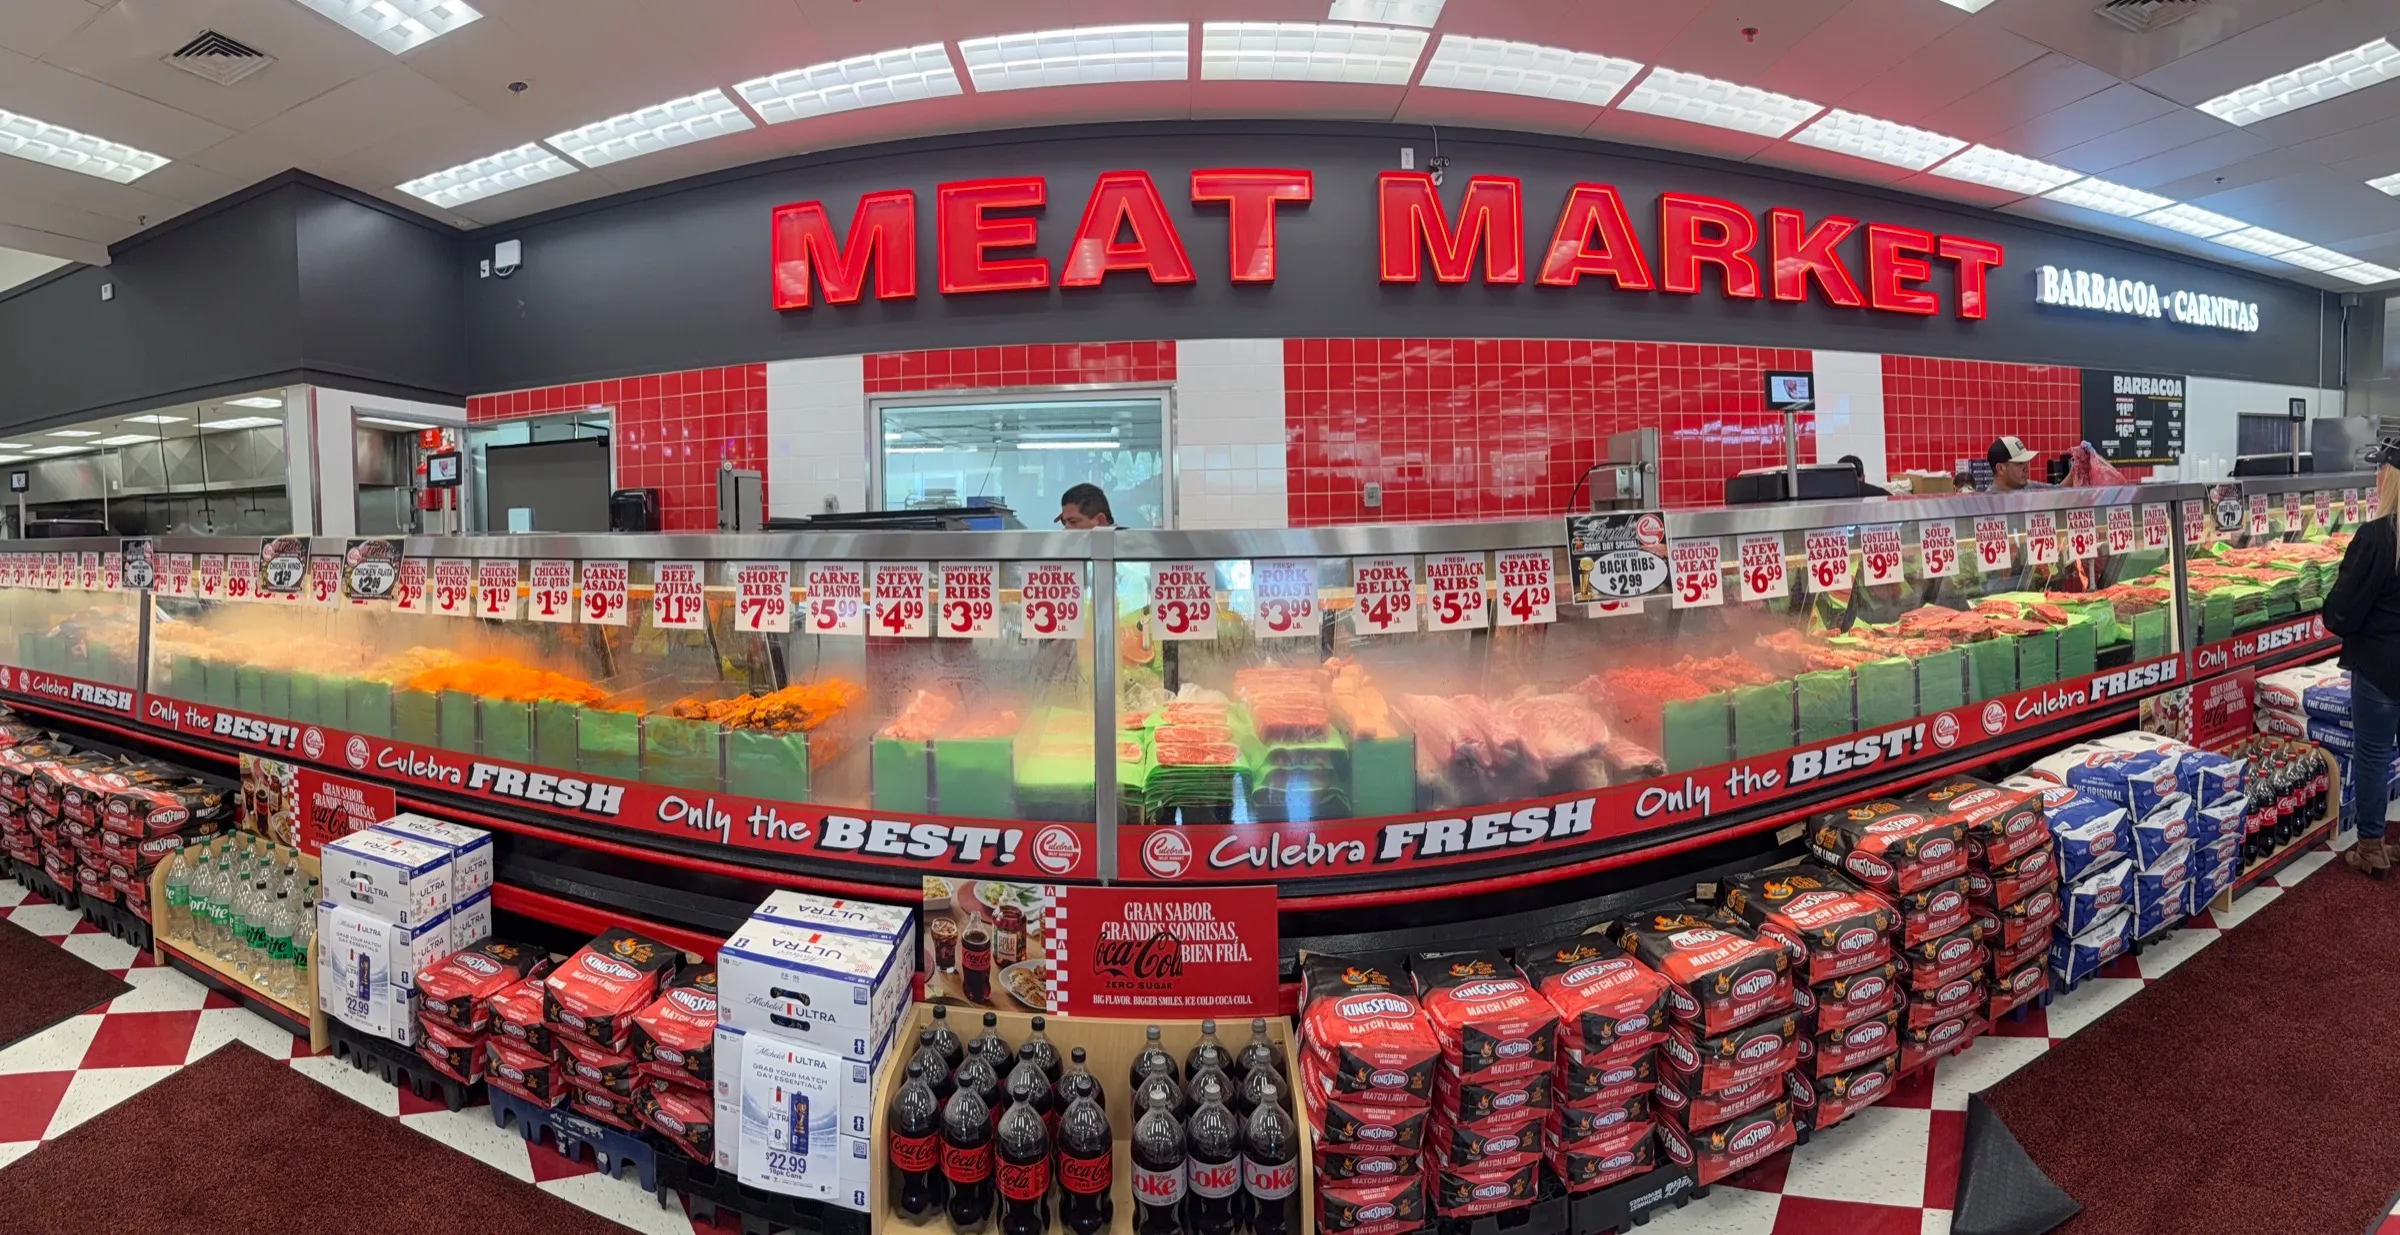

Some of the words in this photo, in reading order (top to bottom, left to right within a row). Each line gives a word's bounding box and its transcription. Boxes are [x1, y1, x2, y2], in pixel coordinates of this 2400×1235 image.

[771, 169, 1313, 312] MEAT
[1377, 171, 2003, 321] MARKET
[2035, 265, 2162, 318] BARBACOA
[2168, 290, 2258, 332] CARNITAS
[2114, 376, 2182, 396] BARBACOA
[2067, 511, 2094, 521] CARNE
[2108, 513, 2131, 522] CARNE
[2031, 518, 2051, 528] BEEF
[2068, 520, 2094, 530] ASADA
[2109, 520, 2132, 529] CECINA
[1862, 531, 1900, 544] COSTILLA
[1925, 528, 1951, 539] SOUP
[2027, 527, 2056, 537] MILANESA
[1584, 542, 1601, 551] GAME
[1603, 542, 1613, 550] DAY
[1615, 540, 1638, 549] SPECIAL
[1806, 536, 1847, 549] CARNE
[1863, 543, 1900, 555] CARGADA
[1922, 538, 1955, 549] BONES
[1671, 547, 1719, 561] GROUND
[1742, 543, 1779, 556] STEW
[1808, 548, 1848, 561] ASADA
[230, 561, 250, 569] FRYER
[312, 562, 339, 570] CHICKEN
[1500, 559, 1550, 573] SPARE
[1600, 560, 1628, 574] BACK
[1631, 557, 1655, 571] RIBS
[1675, 560, 1716, 573] MEAT
[1743, 554, 1780, 567] MEAT
[201, 567, 222, 575] BREAST
[312, 571, 337, 580] FAJITA
[435, 566, 470, 576] CHICKEN
[480, 567, 517, 577] CHICKEN
[583, 568, 626, 580] CARNE
[662, 571, 695, 581] BEEF
[1262, 570, 1309, 583] PORK
[1359, 567, 1408, 581] PORK
[1427, 563, 1484, 577] BABYBACK
[437, 576, 468, 586] WINGS
[479, 578, 517, 587] DRUMS
[738, 571, 788, 583] SHORT
[810, 572, 860, 584] CARNE
[877, 573, 923, 585] STEW
[945, 572, 991, 585] PORK
[1028, 572, 1076, 585] PORK
[1158, 572, 1207, 585] PORK
[1433, 576, 1479, 591] RIBS
[1504, 572, 1547, 586] RIBS
[583, 580, 626, 592] ASADA
[655, 582, 702, 596] FAJITAS
[743, 584, 782, 596] RIBS
[808, 586, 820, 597] AL
[823, 585, 861, 598] PASTOR
[876, 586, 923, 598] MEAT
[1023, 586, 1080, 599] CHOPS
[1258, 583, 1312, 598] ROAST
[1356, 580, 1412, 594] BELLY
[945, 587, 991, 599] RIBS
[1155, 586, 1212, 600] STEAK
[2199, 645, 2227, 669] Only
[2233, 640, 2253, 654] the
[2257, 621, 2310, 653] BEST!
[32, 676, 68, 697] Culebra
[70, 682, 132, 711] FRESH
[2014, 691, 2084, 721] Culebra
[2090, 658, 2177, 701] FRESH
[2306, 700, 2317, 709] THE
[2319, 702, 2349, 715] ORIGINAL
[150, 701, 179, 729] Only
[184, 706, 210, 729] the
[213, 713, 299, 749] BEST!
[1635, 776, 1710, 819] Only
[1725, 763, 1780, 802] the
[1788, 723, 1926, 784] BEST!
[377, 747, 461, 785] Culebra
[466, 762, 624, 816] FRESH
[151, 810, 186, 824] KINGSFORD
[658, 795, 731, 844] Only
[748, 805, 811, 840] the
[819, 816, 1023, 866] BEST!
[1208, 832, 1365, 870] Culebra
[1374, 798, 1596, 863] FRESH
[364, 886, 389, 898] ULTRA
[1124, 902, 1162, 921] GRAN
[1166, 902, 1215, 921] SABOR.
[1102, 921, 1165, 940] GRANDES
[1169, 921, 1239, 940] SONRISAS.
[1841, 933, 1874, 950] KINGSFORD
[1181, 944, 1212, 962] BIEN
[1216, 940, 1252, 962] FRÍA.
[456, 954, 498, 974] KINGSFORD
[585, 954, 637, 982] KINGSFORD
[1567, 960, 1626, 984] KINGSFORD
[1106, 981, 1134, 989] ZERO
[1455, 981, 1518, 999] KINGSFORD
[1735, 974, 1772, 995] KINGSFORD
[1093, 995, 1104, 1004] BIG
[1105, 995, 1132, 1004] FLAVOR.
[1133, 996, 1157, 1005] BIGGER
[1158, 996, 1183, 1005] SMILES.
[1185, 996, 1196, 1005] ICE
[1197, 996, 1214, 1005] COLD
[1465, 1004, 1499, 1017] MATCH
[1499, 996, 1530, 1012] LIGHT
[745, 993, 784, 1012] Michelob
[795, 1008, 836, 1023] ULTRA
[1342, 998, 1408, 1017] KINGSFORD
[1348, 1021, 1385, 1034] MATCH
[1386, 1021, 1415, 1033] LIGHT
[1497, 1042, 1530, 1055] KINGSFORD
[754, 1045, 786, 1060] Michelob
[795, 1055, 827, 1069] ULTRA
[752, 1063, 774, 1074] GRAB
[774, 1068, 797, 1078] YOUR
[798, 1074, 828, 1085] MATCH
[756, 1071, 772, 1080] DAY
[774, 1075, 823, 1091] ESSENTIALS
[765, 1151, 806, 1174] $22.99
[786, 1170, 802, 1180] Cans
[1244, 1161, 1296, 1190] Coke
